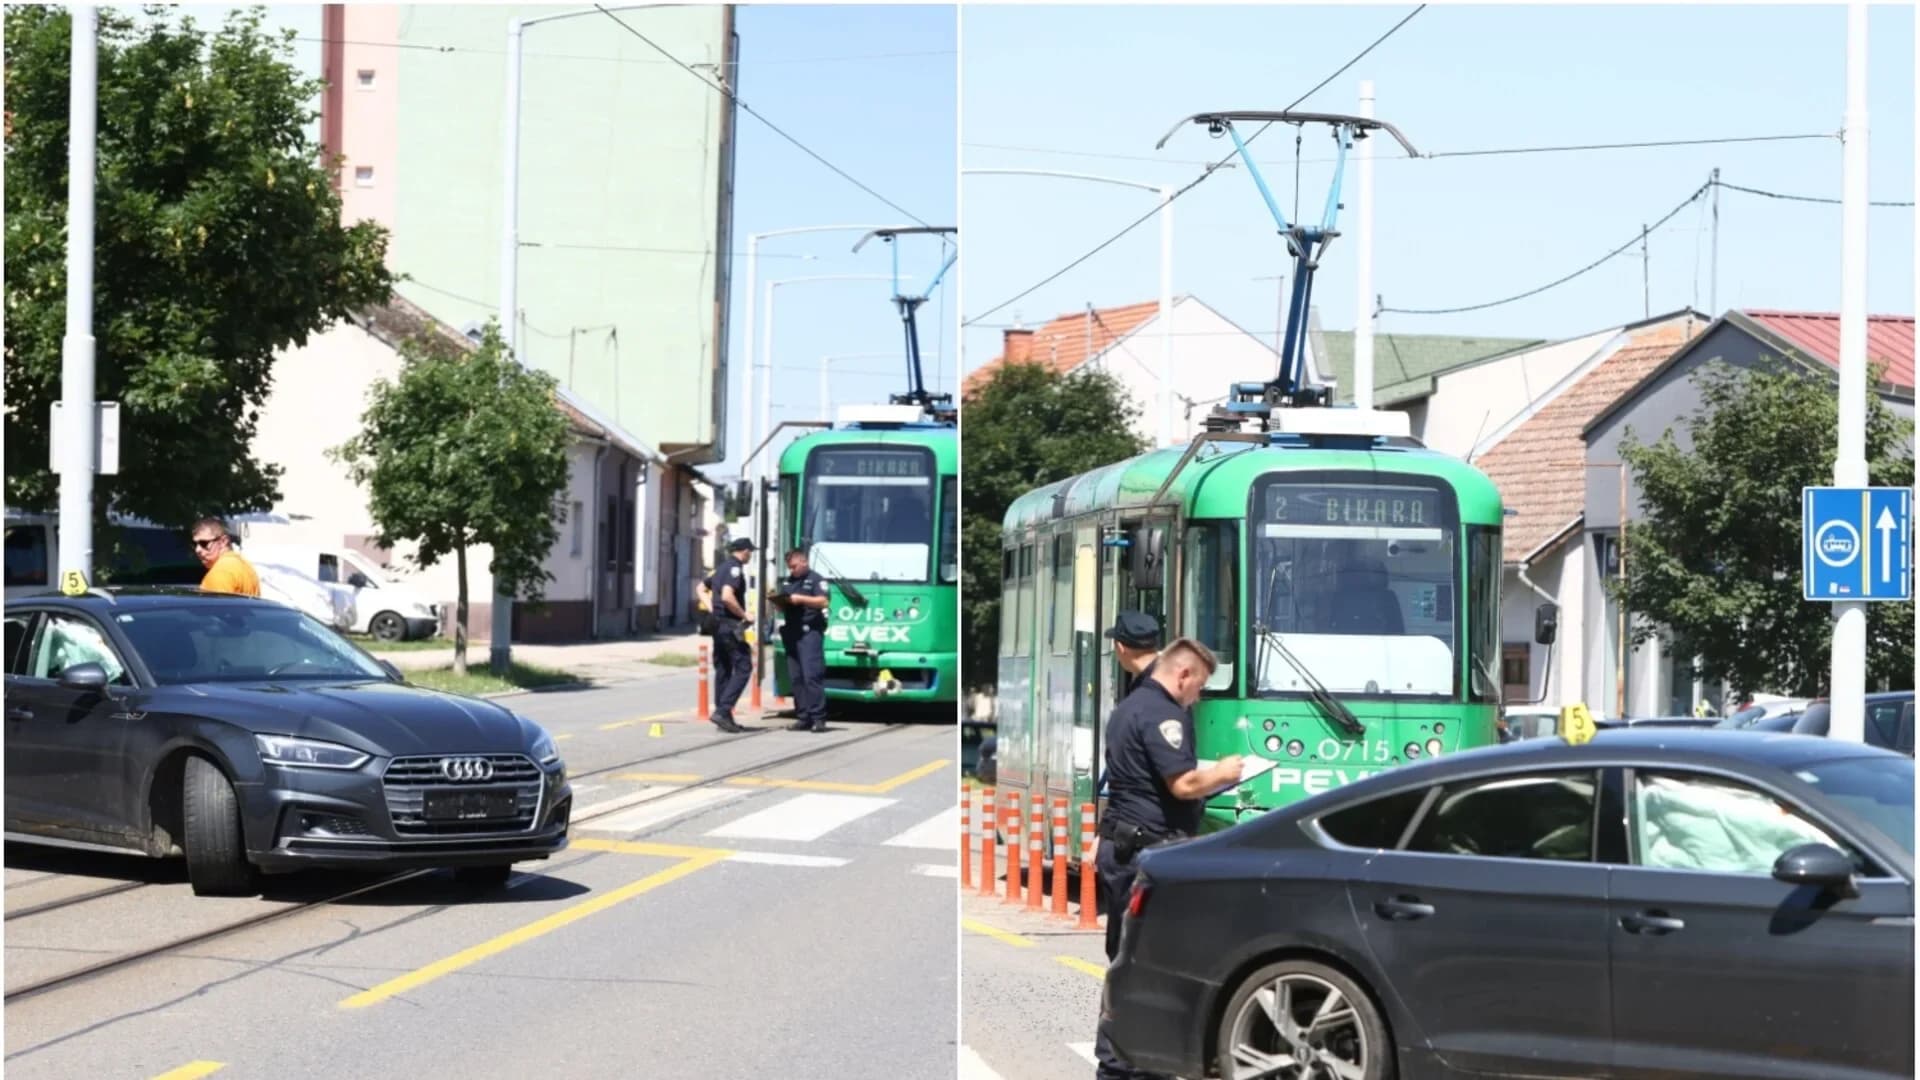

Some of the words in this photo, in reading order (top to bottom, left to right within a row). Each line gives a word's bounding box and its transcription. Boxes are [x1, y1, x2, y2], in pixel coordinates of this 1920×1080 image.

[1275, 496, 1288, 520] 2
[69, 572, 79, 588] 5
[824, 625, 911, 643] EVEX
[1572, 706, 1585, 730] 5
[1318, 738, 1389, 762] 0715
